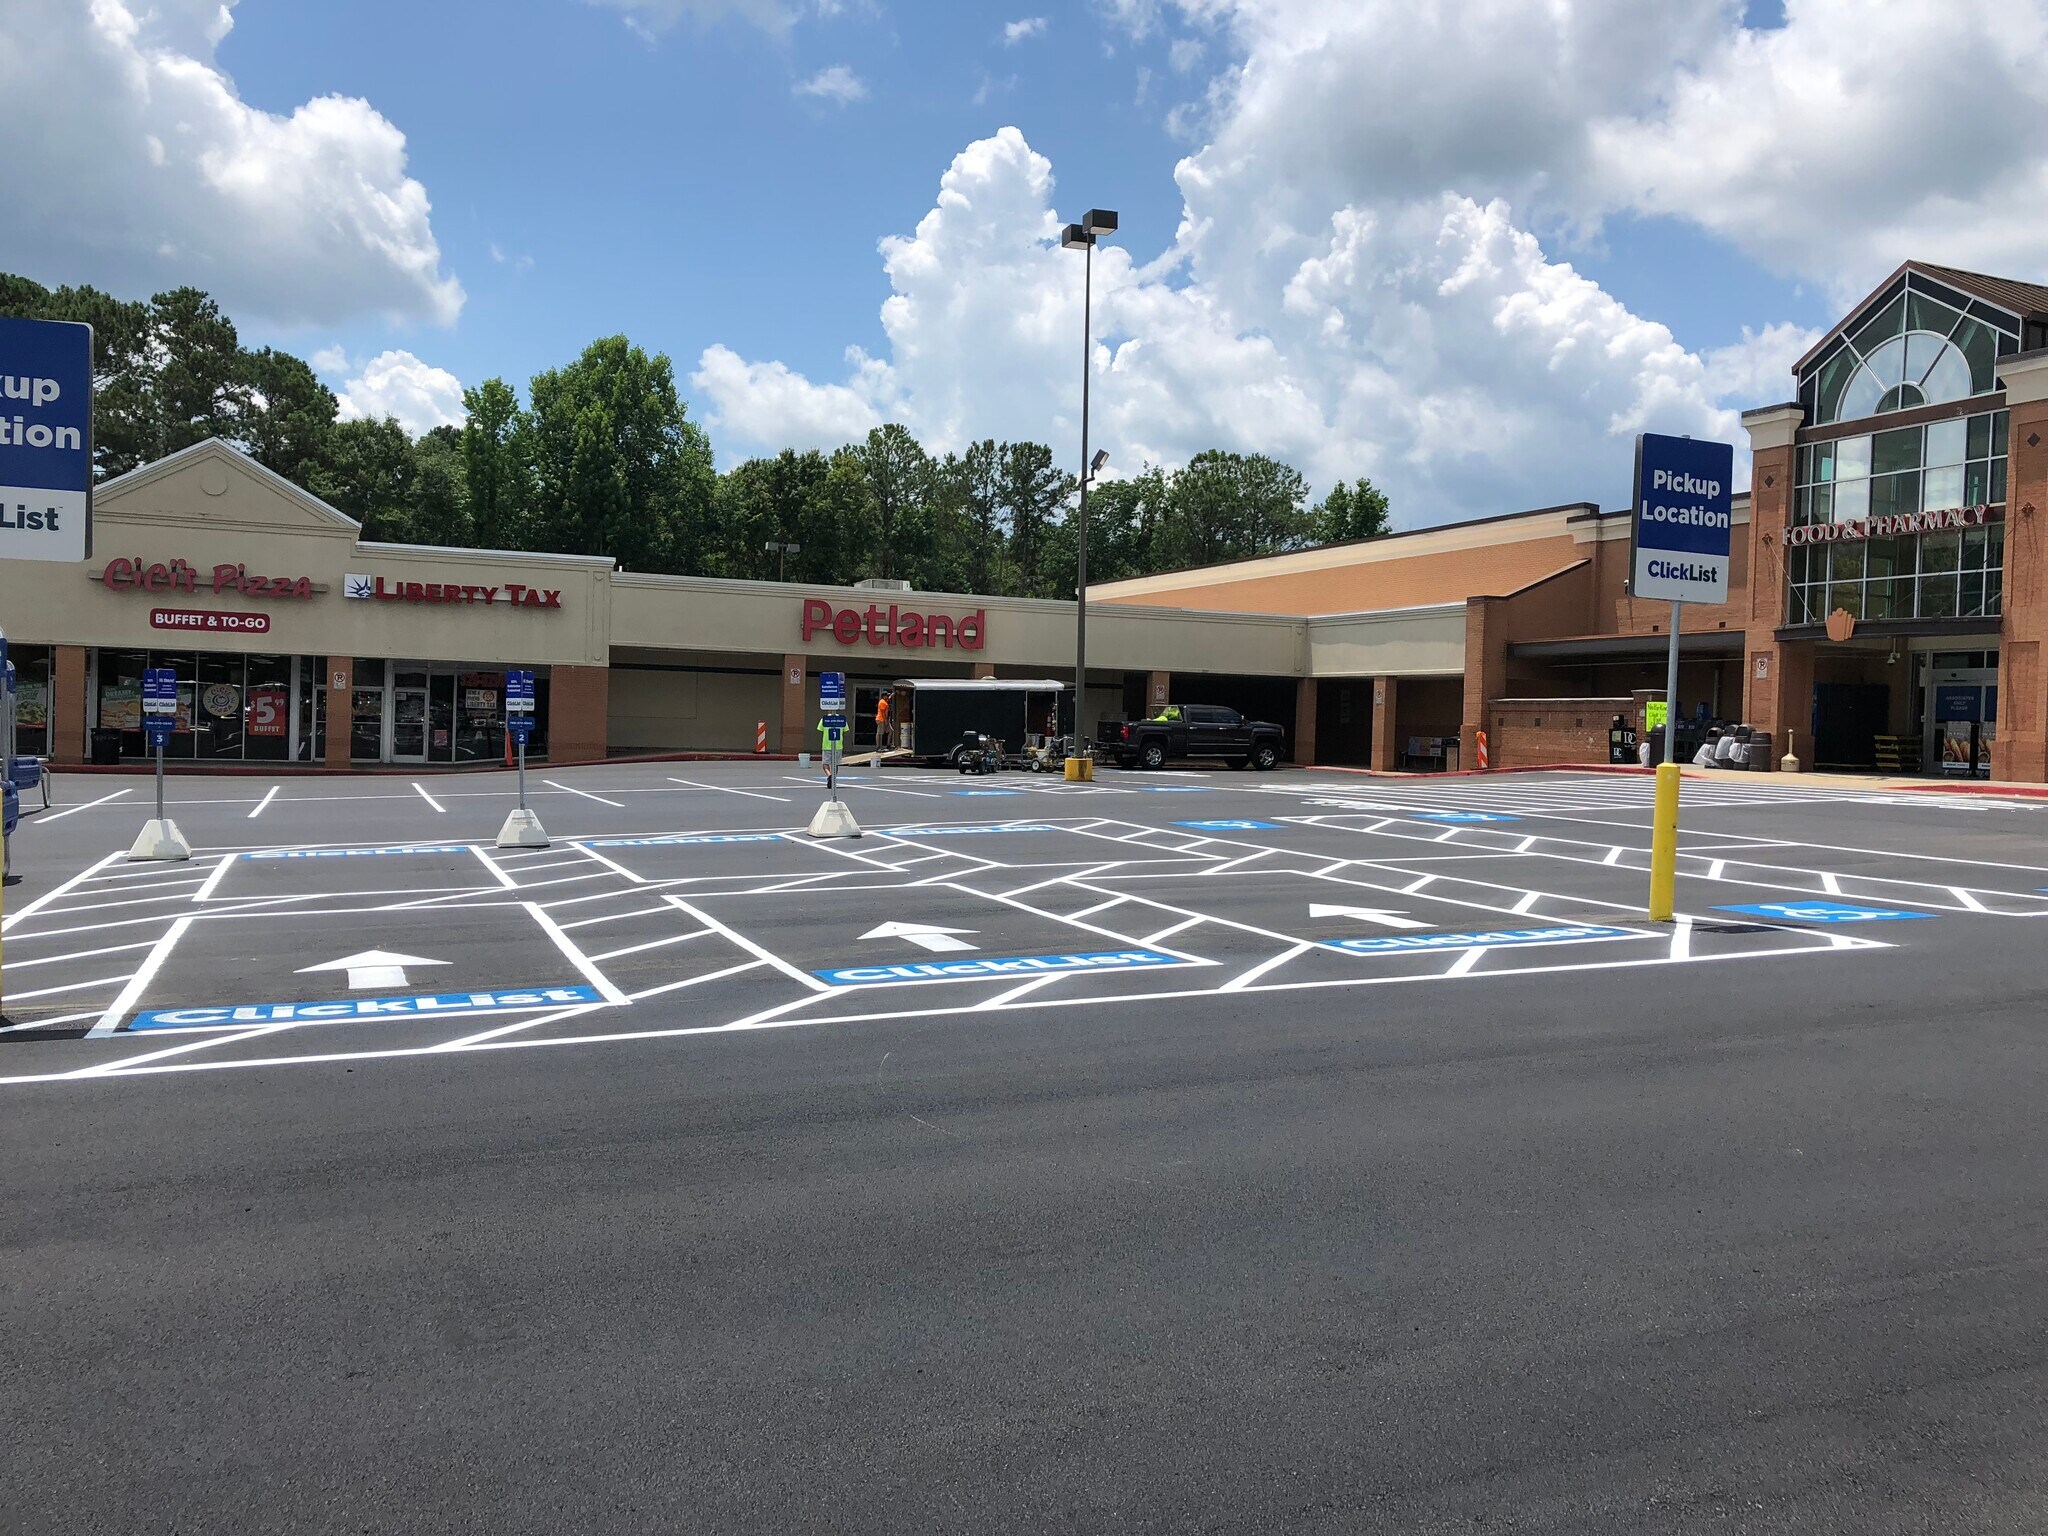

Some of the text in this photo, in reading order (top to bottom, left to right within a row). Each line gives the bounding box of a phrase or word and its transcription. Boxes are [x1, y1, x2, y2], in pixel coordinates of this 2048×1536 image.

[1653, 469, 1721, 500] Pickup
[1641, 500, 1728, 529] Location
[1782, 504, 1990, 546] FOOD & PHARMACY
[1647, 559, 1718, 583] ClickList
[375, 576, 562, 609] LIBERTY TAX
[155, 612, 266, 629] BUFFET & TO-GO
[802, 598, 986, 650] Petland
[156, 734, 163, 743] 3
[254, 725, 280, 733] BUFFET
[832, 951, 1165, 982] ClickList
[150, 989, 587, 1024] ClickList
